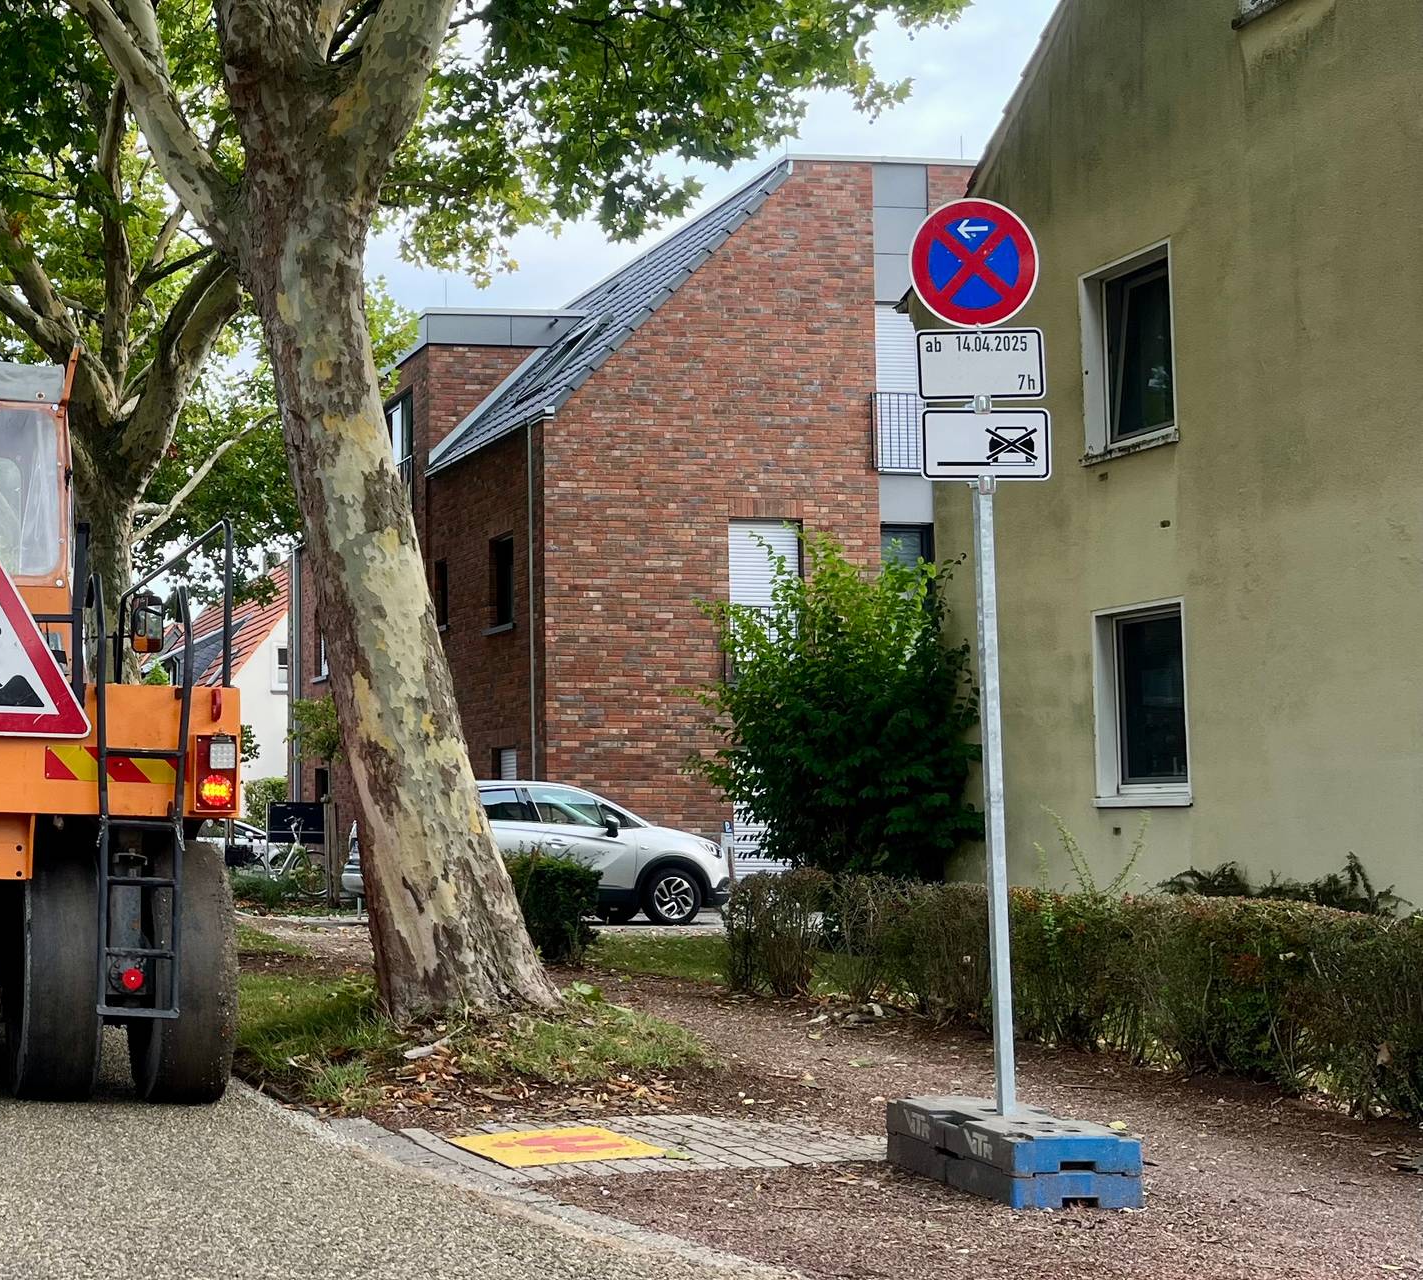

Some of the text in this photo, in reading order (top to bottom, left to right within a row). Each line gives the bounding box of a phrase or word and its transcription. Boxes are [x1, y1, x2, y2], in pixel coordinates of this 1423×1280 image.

[925, 335, 1027, 352] ab 14.04.2025
[1018, 374, 1035, 390] 7h
